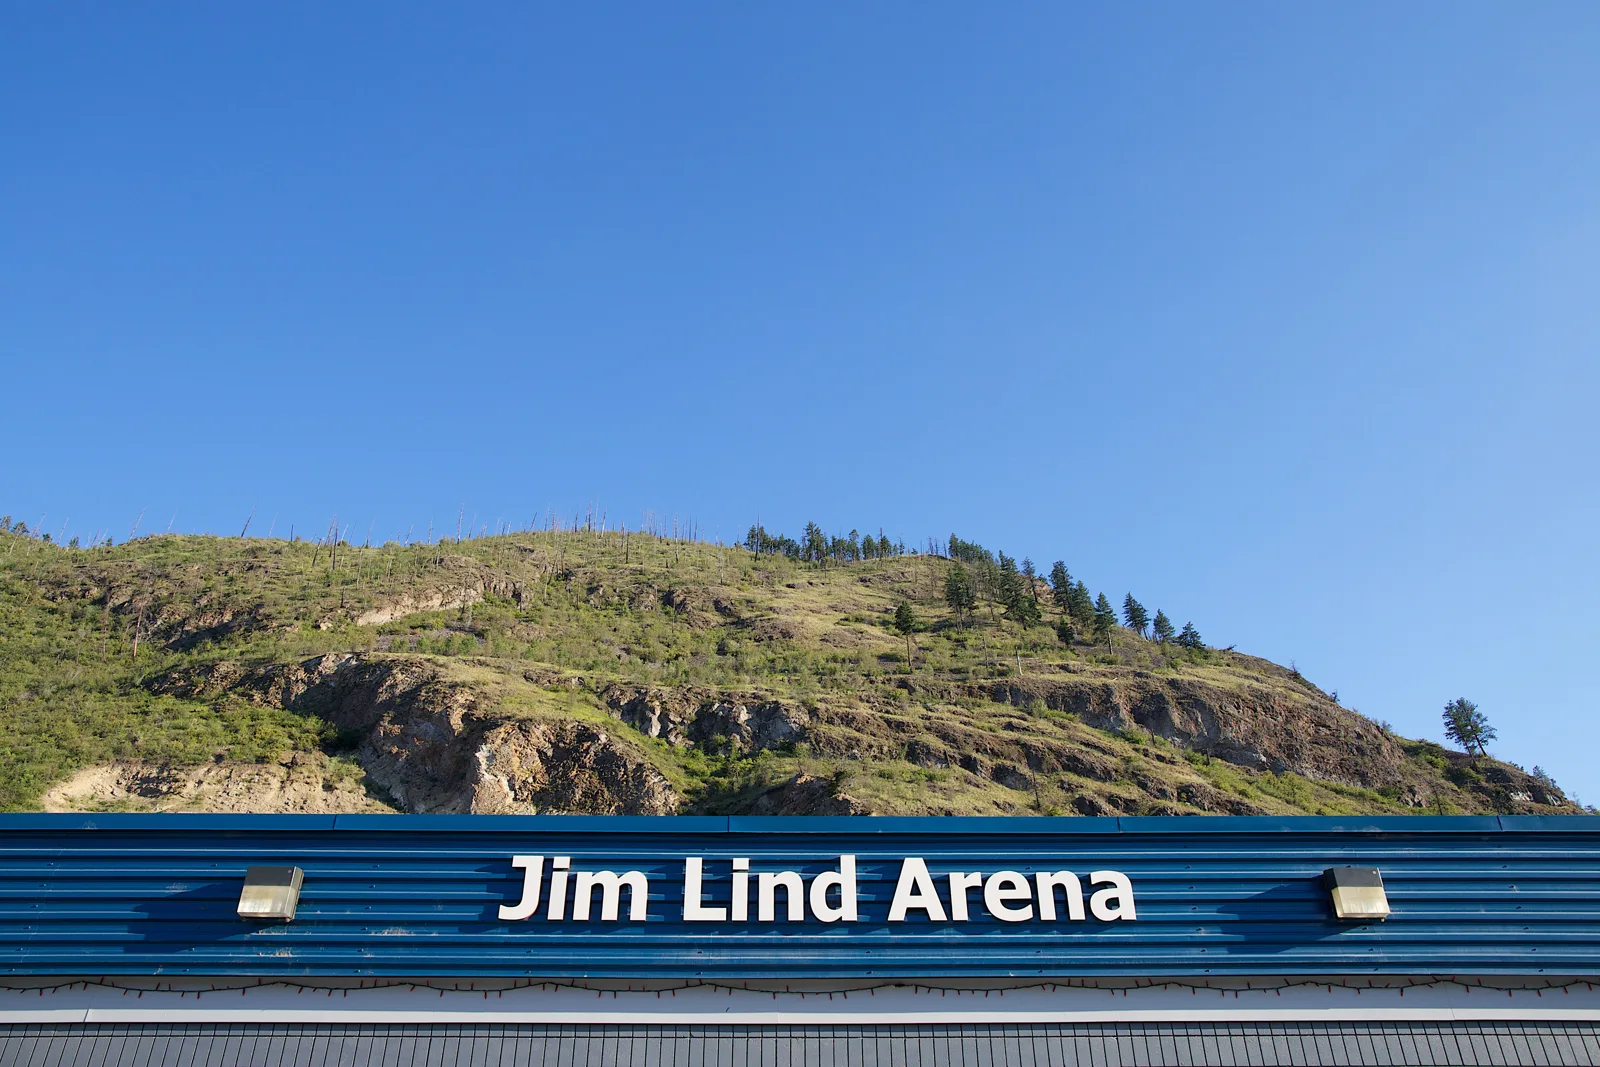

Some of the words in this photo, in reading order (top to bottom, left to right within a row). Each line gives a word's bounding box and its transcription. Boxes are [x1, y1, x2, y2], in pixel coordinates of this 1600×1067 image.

[498, 855, 648, 921] Jim
[683, 854, 858, 922] Lind
[887, 857, 1137, 922] Arena
